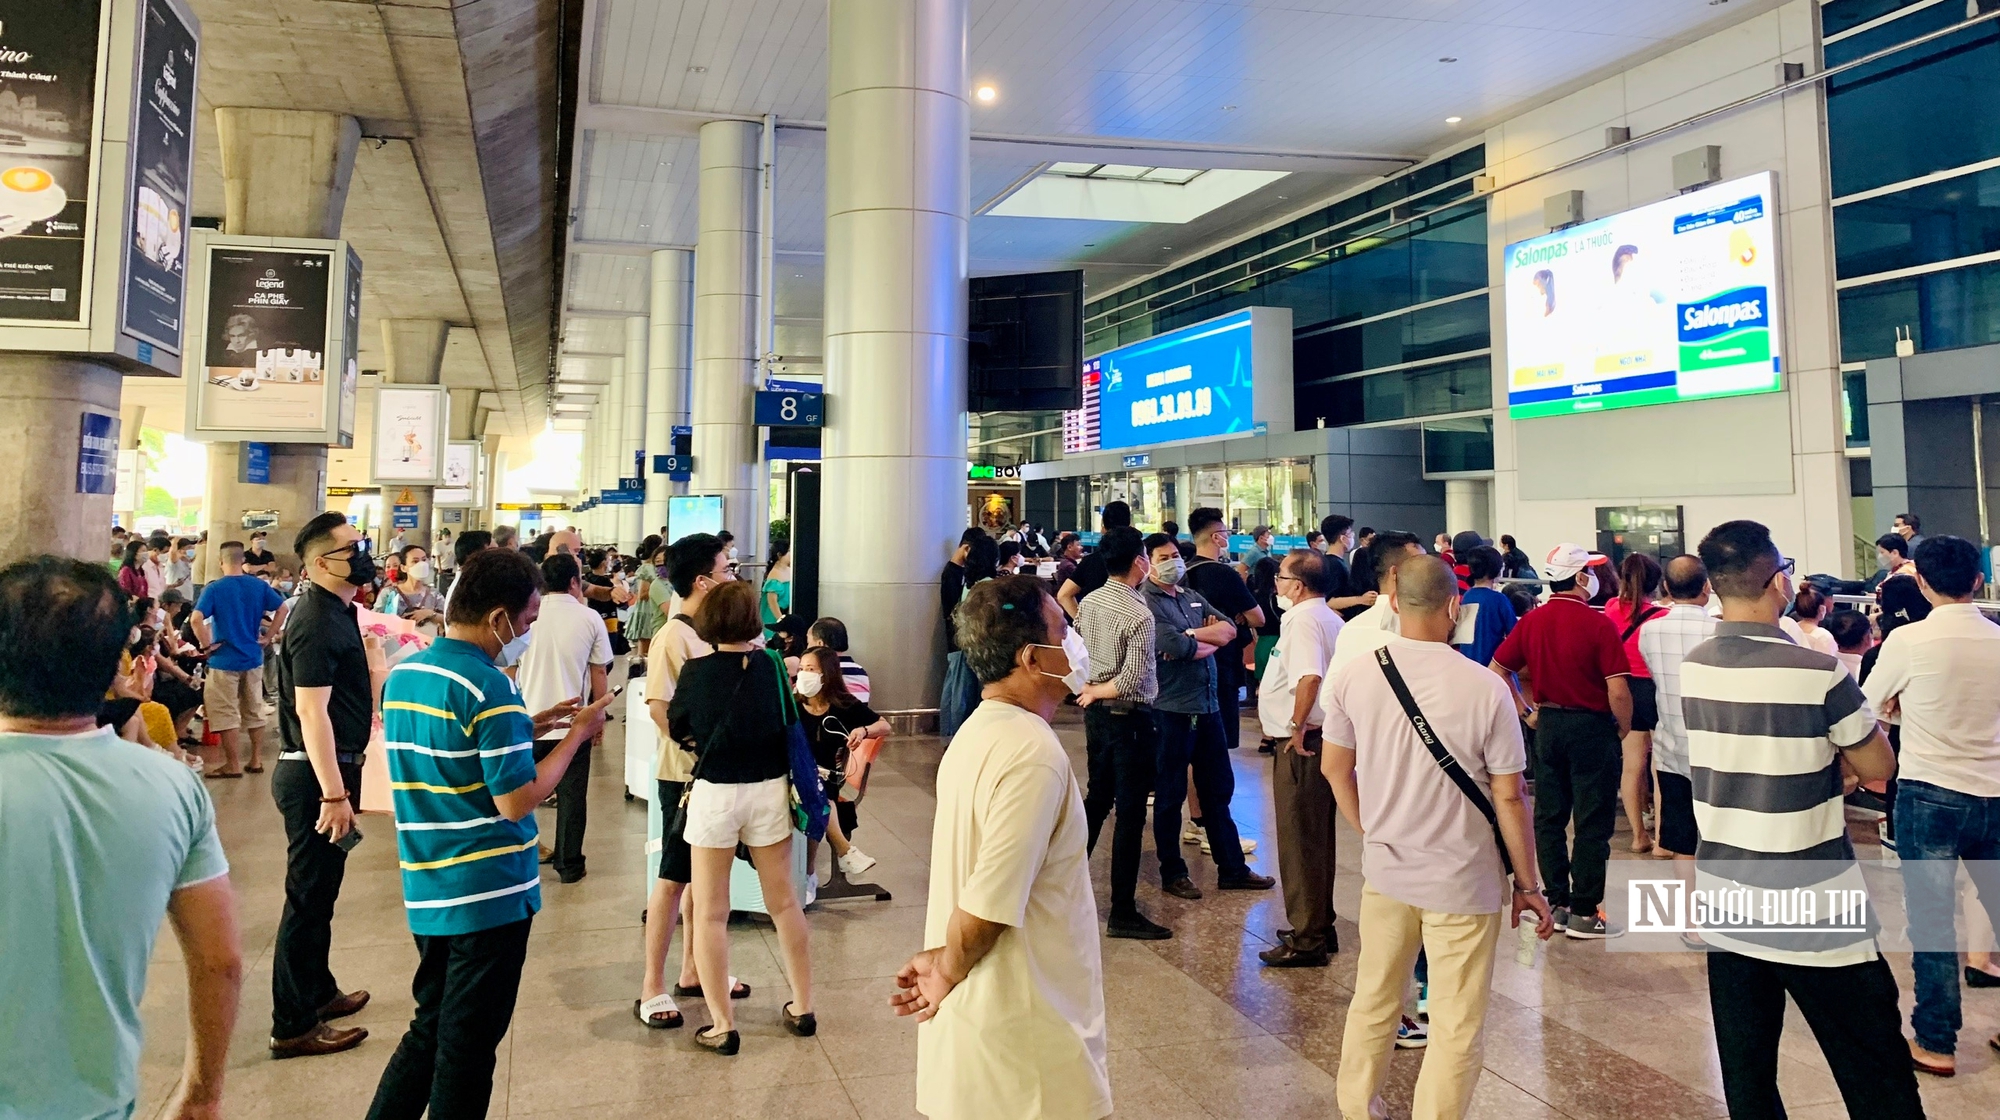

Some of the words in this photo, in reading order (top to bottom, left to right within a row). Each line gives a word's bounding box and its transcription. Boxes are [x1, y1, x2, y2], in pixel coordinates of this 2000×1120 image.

[1515, 241, 1568, 268] Salonpas
[256, 280, 284, 289] Legend
[780, 397, 797, 421] 8
[806, 415, 818, 423] GF
[667, 457, 677, 470] 9
[624, 479, 638, 489] 10
[1413, 715, 1434, 745] Chang
